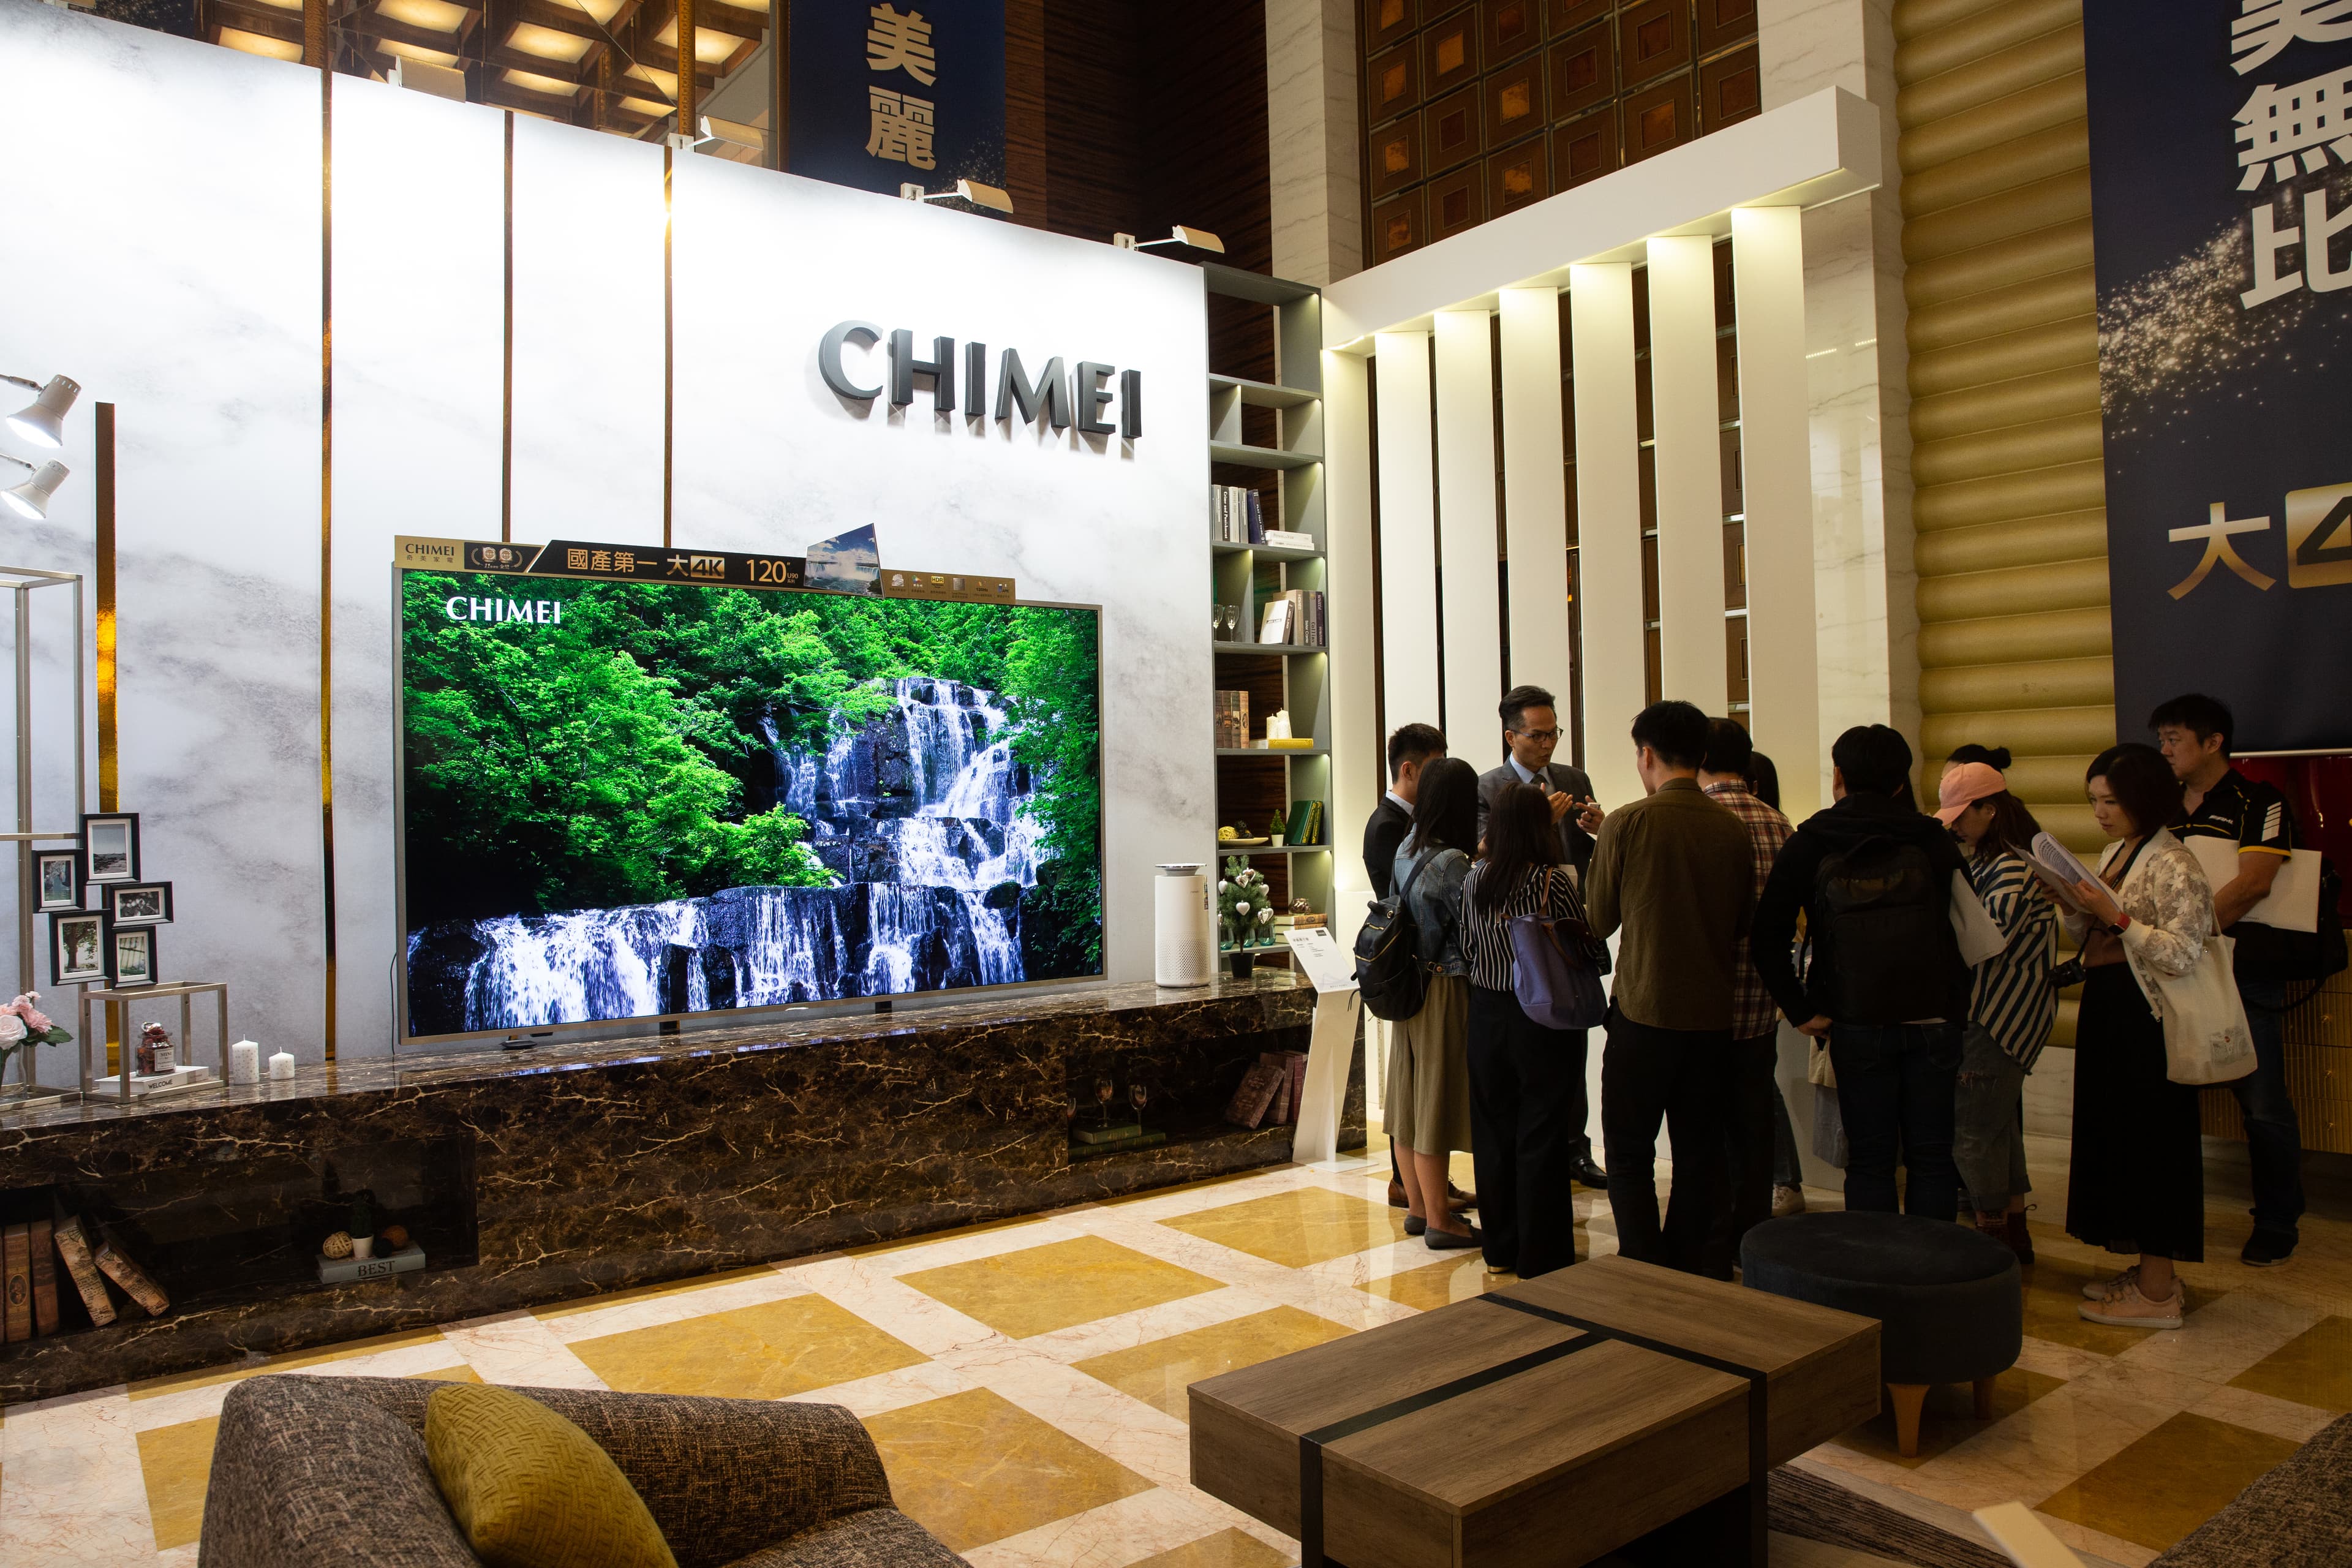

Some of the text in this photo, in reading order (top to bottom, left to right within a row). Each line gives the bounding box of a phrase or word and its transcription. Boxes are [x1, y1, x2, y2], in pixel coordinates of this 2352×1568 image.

[865, 3, 937, 170] 美麗
[818, 320, 1142, 439] CHIMEI
[405, 543, 454, 556] CHIMEI
[567, 549, 657, 573] 國產第一
[446, 596, 560, 624] CHIMEI
[148, 1079, 173, 1090] WELCOME
[358, 1261, 395, 1277] BEST
